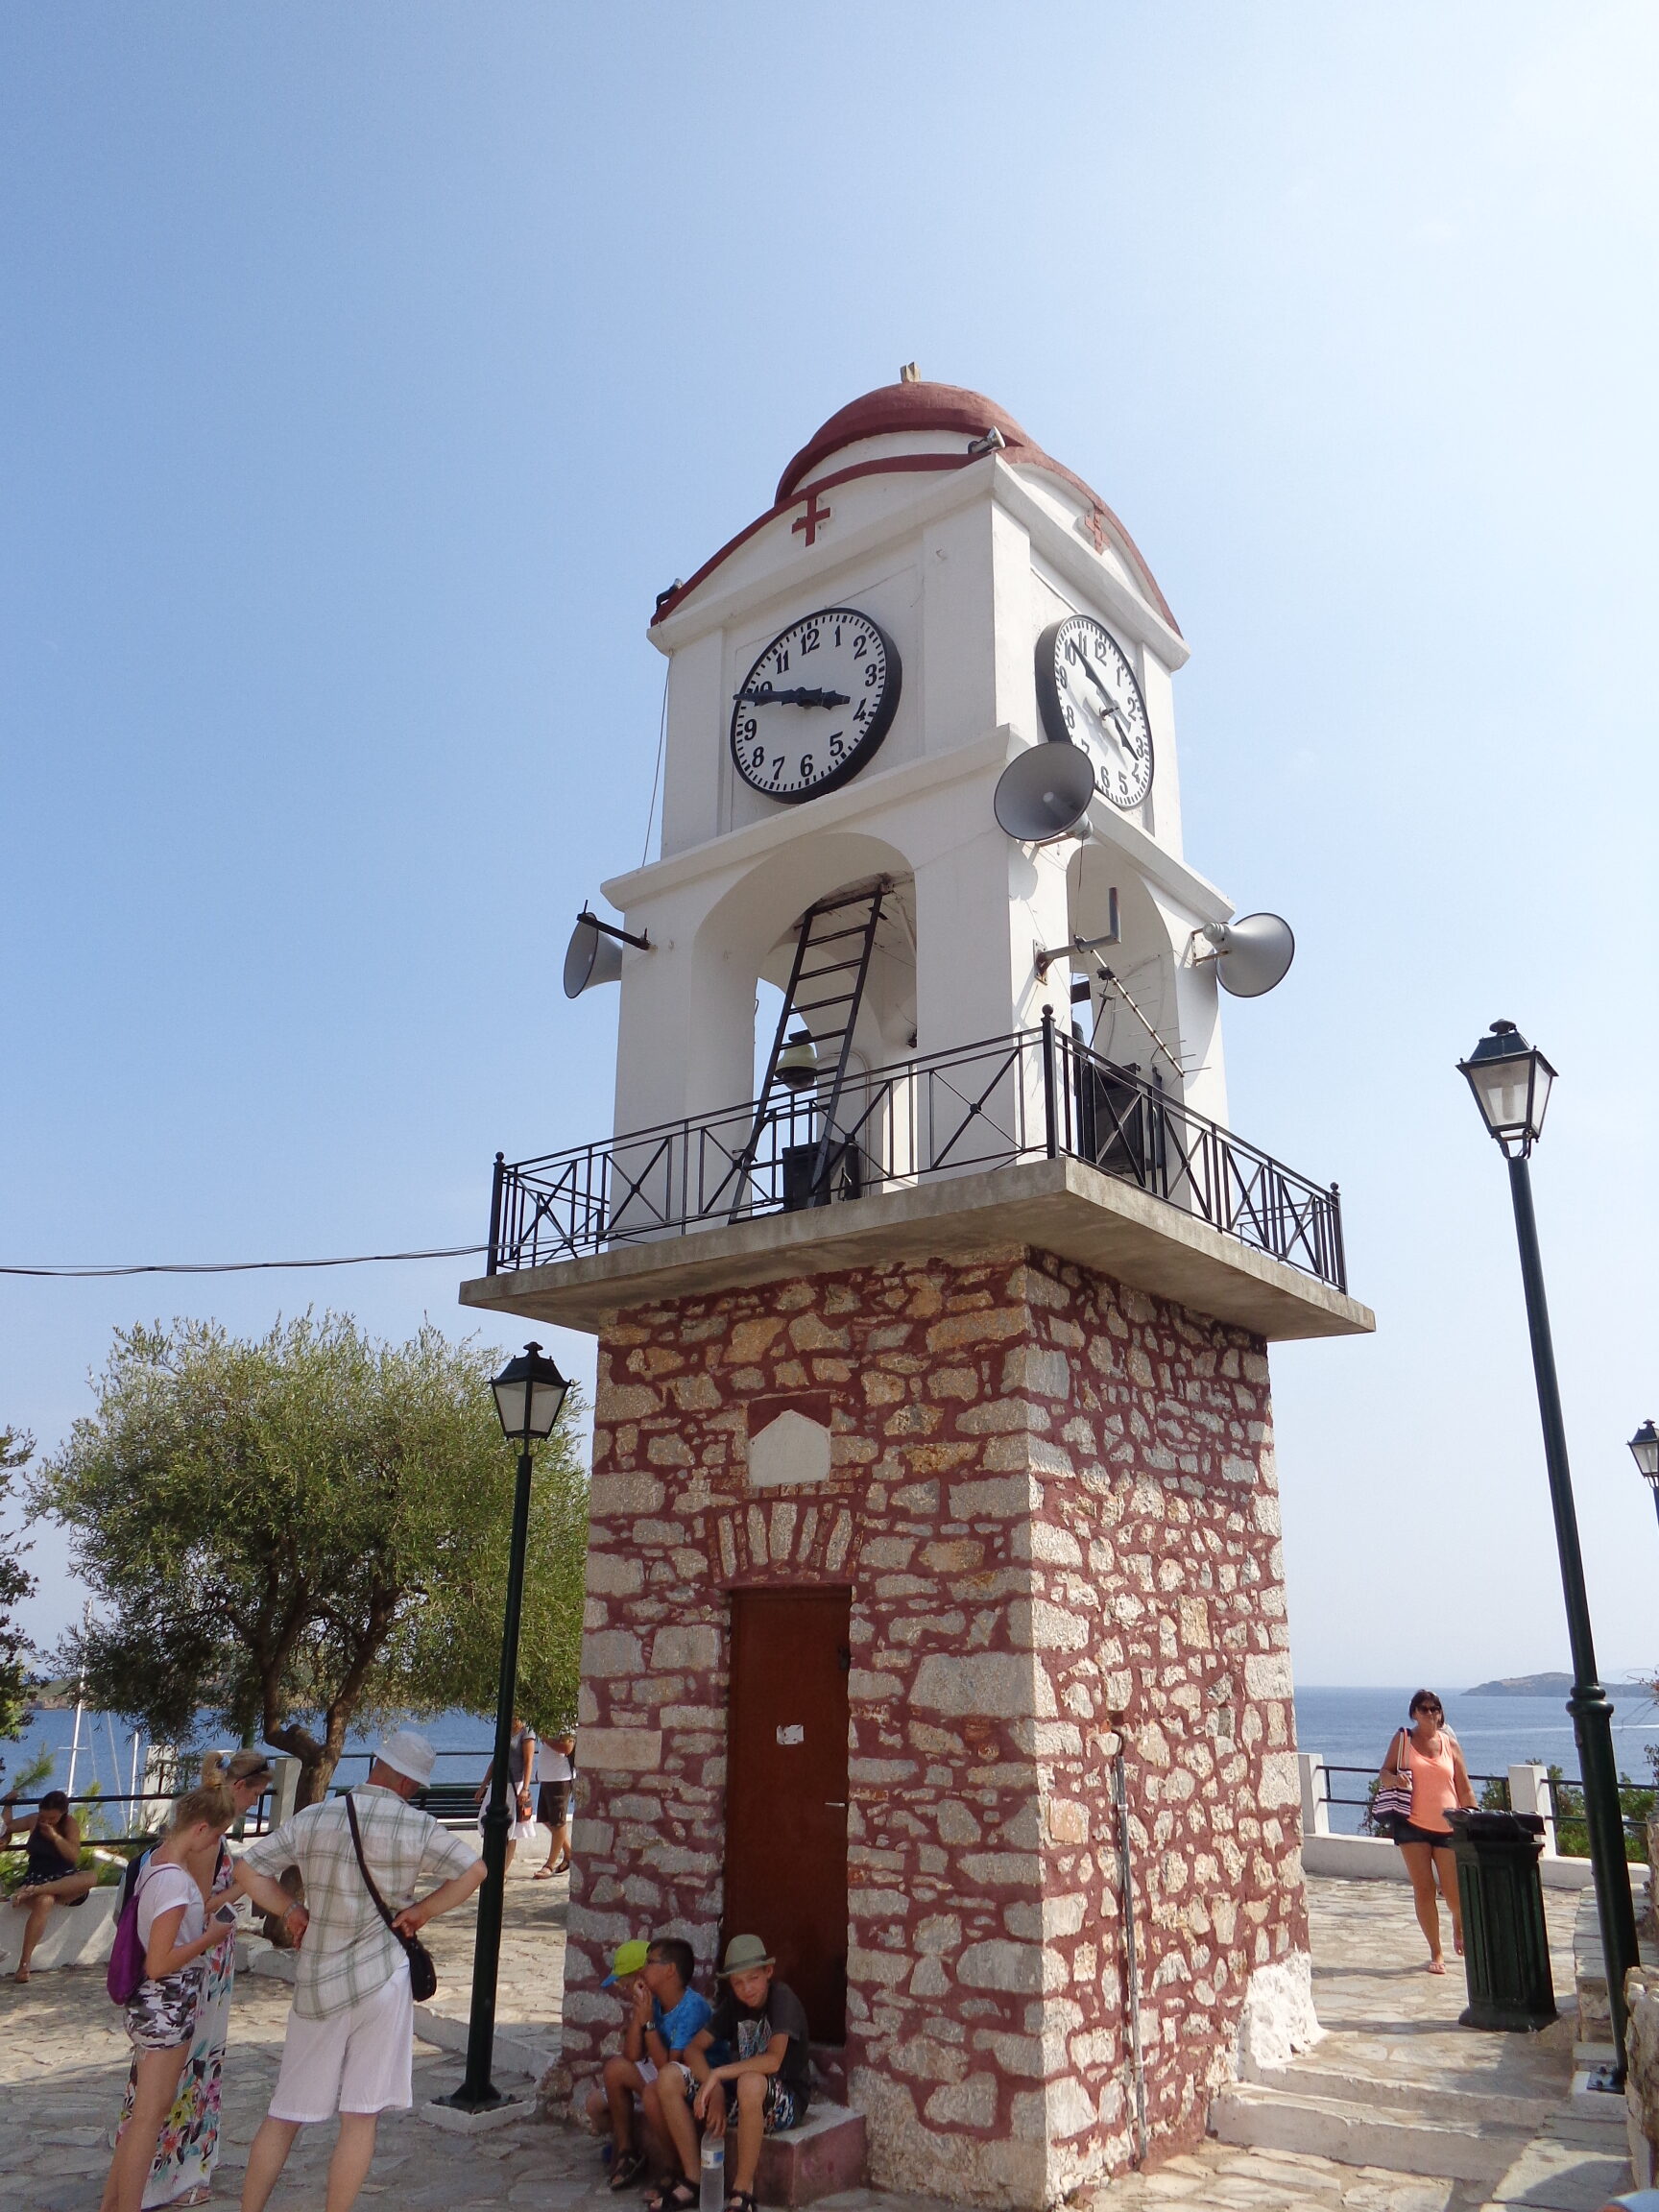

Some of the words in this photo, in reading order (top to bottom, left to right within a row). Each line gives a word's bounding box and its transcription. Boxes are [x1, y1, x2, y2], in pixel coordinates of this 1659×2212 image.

[800, 628, 820, 656] 12
[834, 625, 841, 648] 1
[853, 635, 867, 661] 2
[1078, 631, 1088, 657] 11
[776, 650, 789, 674] 11
[1064, 638, 1076, 666] 10
[1094, 637, 1107, 666] 12
[865, 663, 878, 686] 3
[1059, 665, 1068, 689] 9
[1117, 666, 1120, 687] 1
[853, 698, 866, 721] 4
[1067, 705, 1075, 729] 8
[1127, 696, 1137, 721] 2
[744, 718, 757, 741] 9
[830, 732, 844, 757] 5
[1135, 735, 1144, 758] 3
[752, 746, 764, 768] 8
[772, 756, 785, 781] 7
[800, 754, 813, 777] 6
[1100, 765, 1111, 788] 6
[1118, 770, 1128, 796] 5
